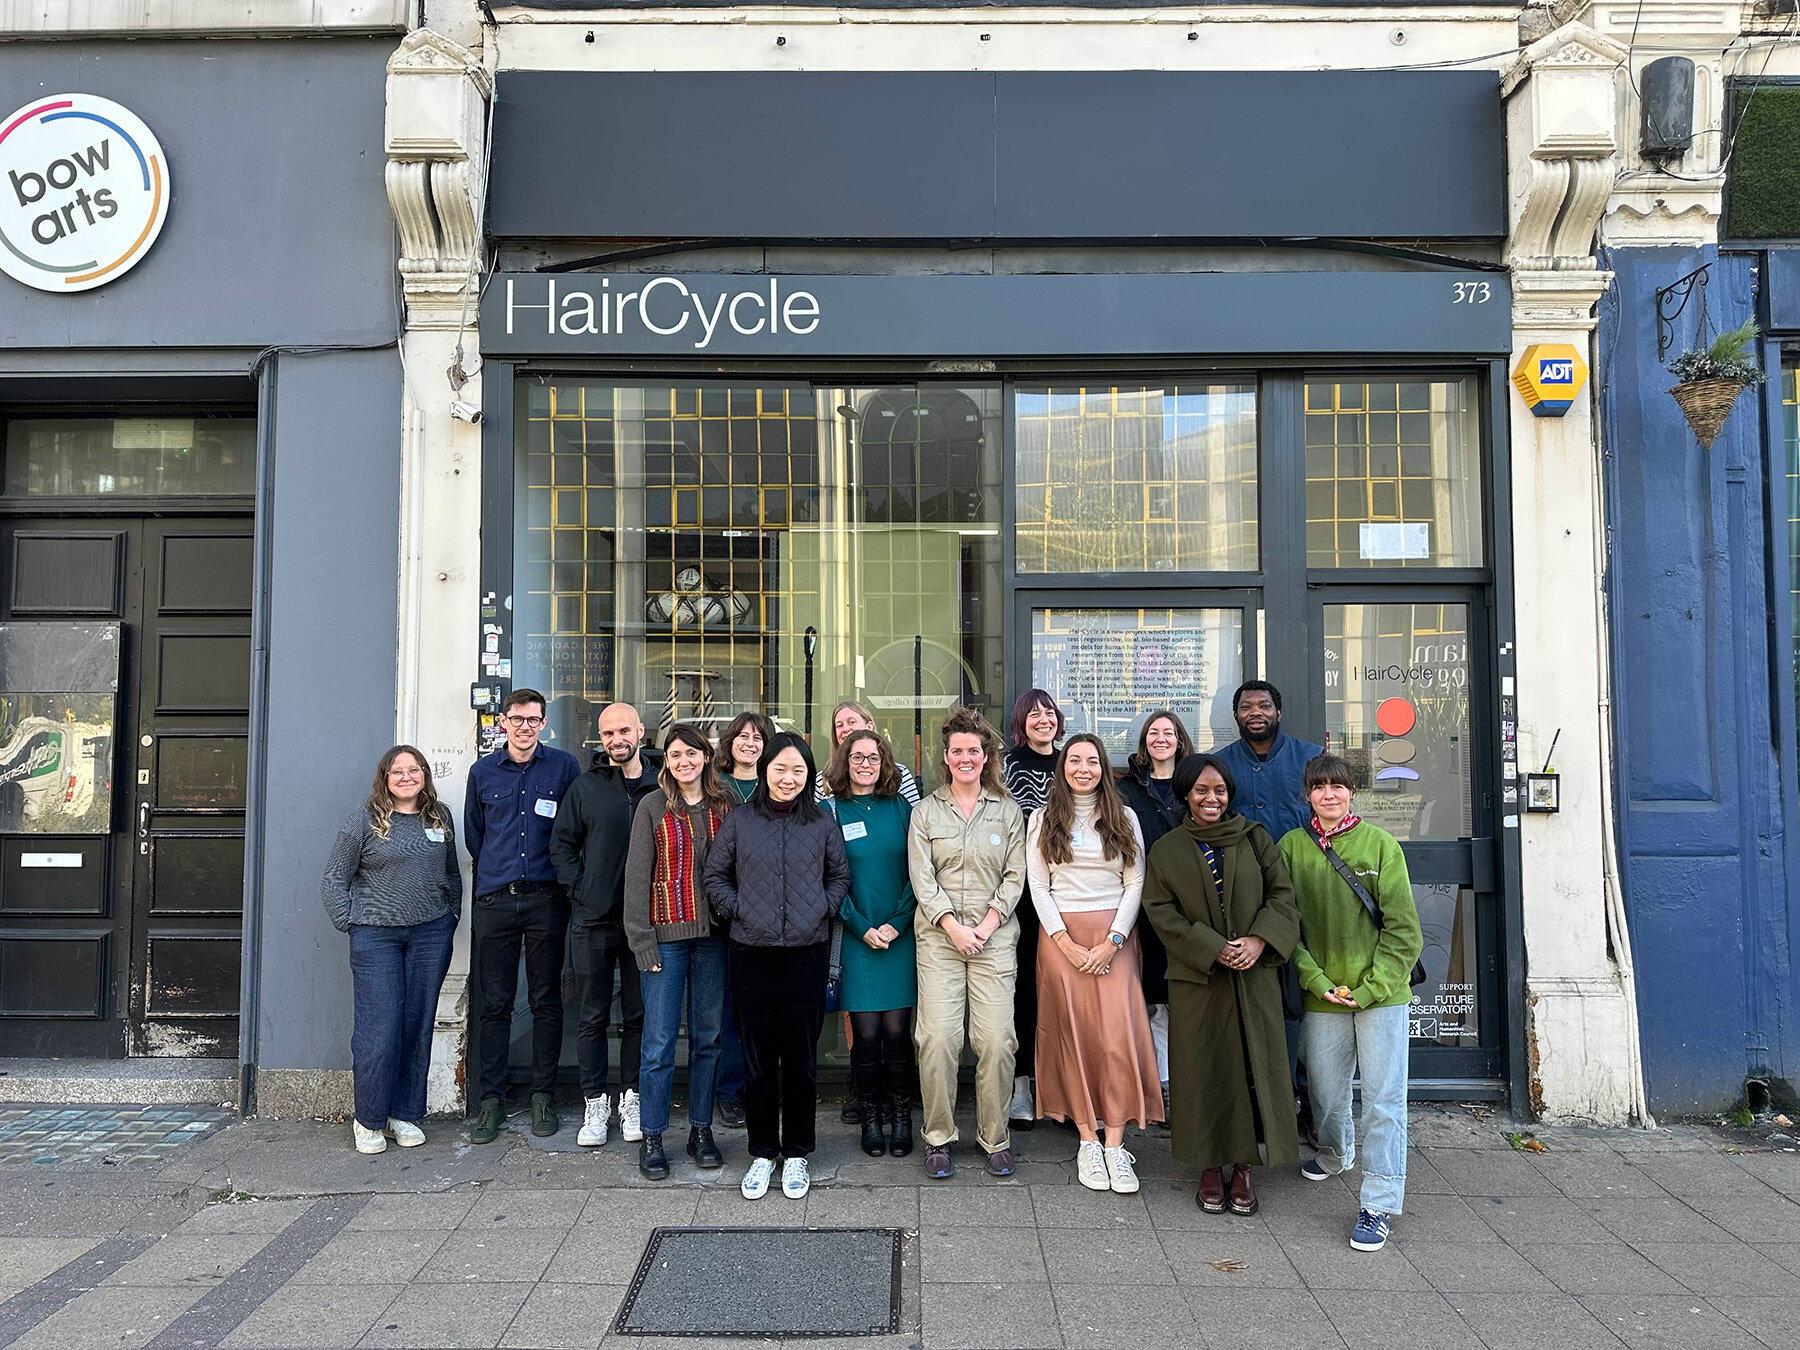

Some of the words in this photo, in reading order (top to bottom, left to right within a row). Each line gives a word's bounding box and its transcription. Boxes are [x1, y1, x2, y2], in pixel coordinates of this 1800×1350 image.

[8, 138, 110, 207] bow
[31, 188, 119, 245] arts
[1452, 281, 1491, 304] 373
[505, 276, 820, 348] HairCycle
[1540, 363, 1573, 380] ADT
[1354, 665, 1433, 683] HairCycle
[1410, 1005, 1474, 1014] BSERVATORY
[1435, 995, 1474, 1004] FUTURE
